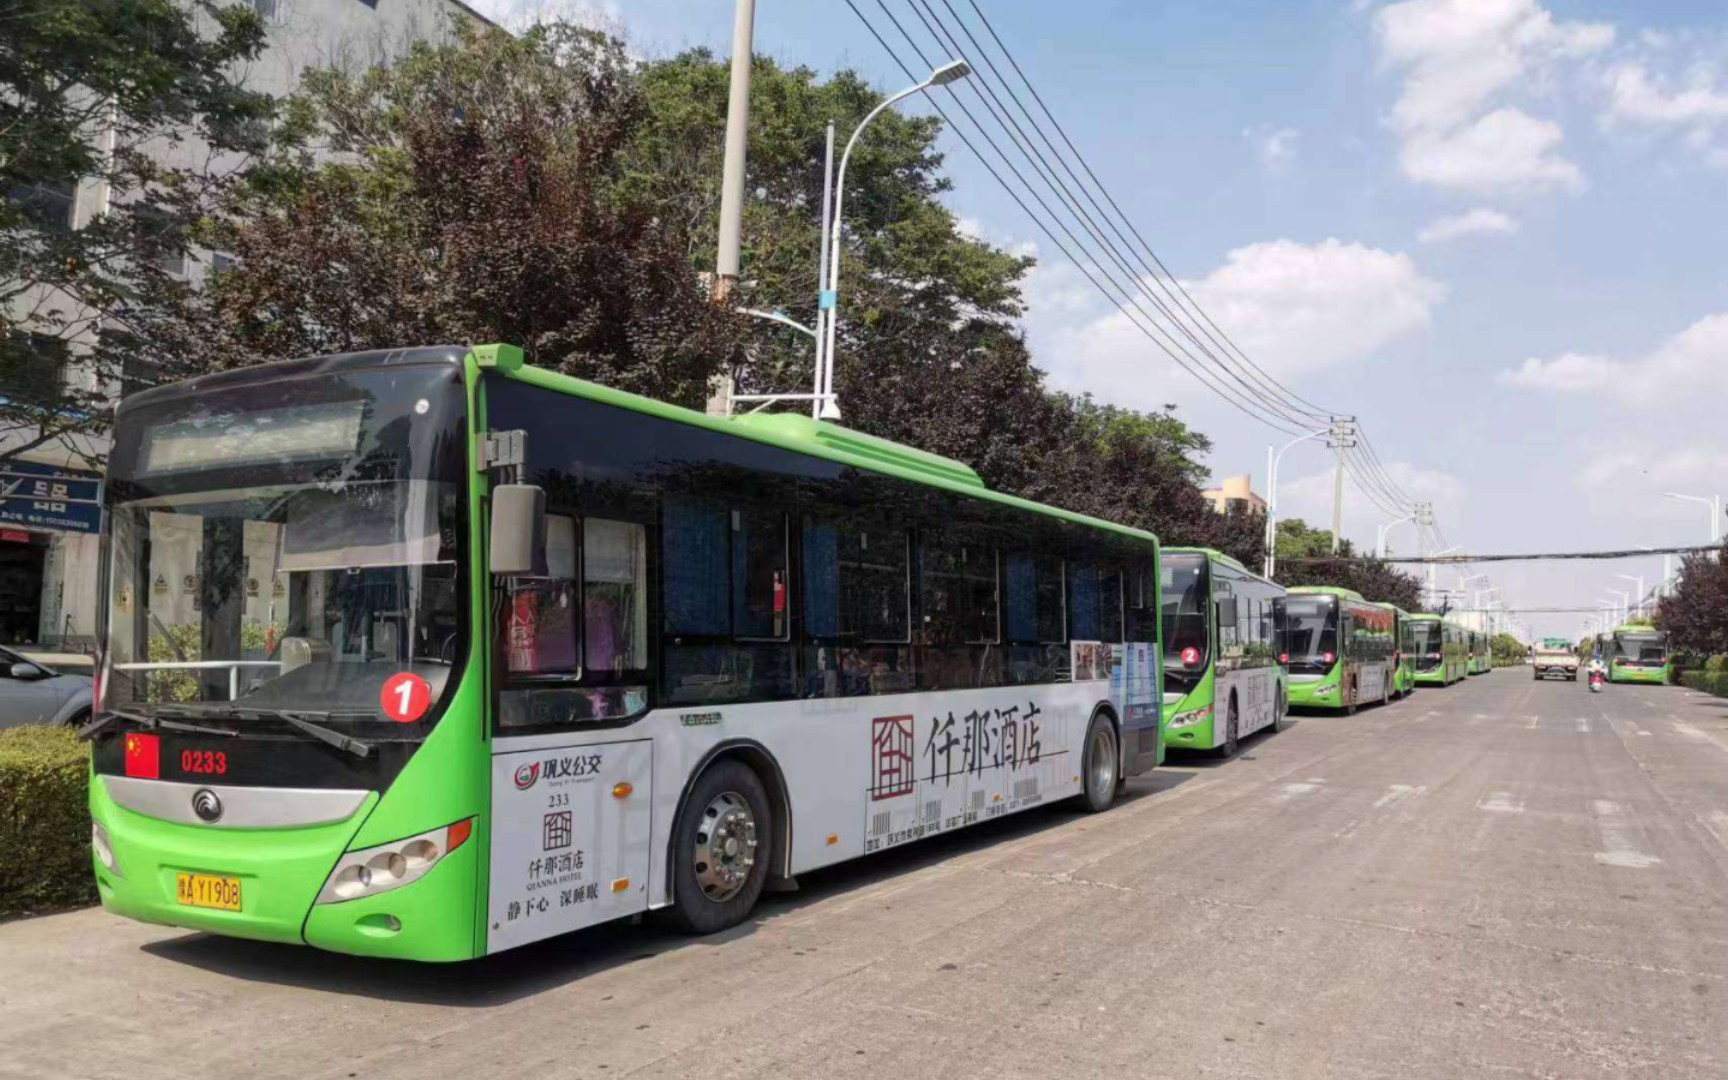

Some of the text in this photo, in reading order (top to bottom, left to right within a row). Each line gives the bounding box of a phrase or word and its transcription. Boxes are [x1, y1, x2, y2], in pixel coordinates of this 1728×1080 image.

[1185, 650, 1195, 662] 2
[394, 680, 412, 716] 1
[923, 701, 1042, 788] 仟那酒店
[181, 749, 227, 774] 0233
[542, 754, 602, 779] 巩义公交
[548, 793, 569, 807] 233
[528, 849, 584, 879] 仟那酒店
[526, 871, 582, 891] QIANNA HOTEL
